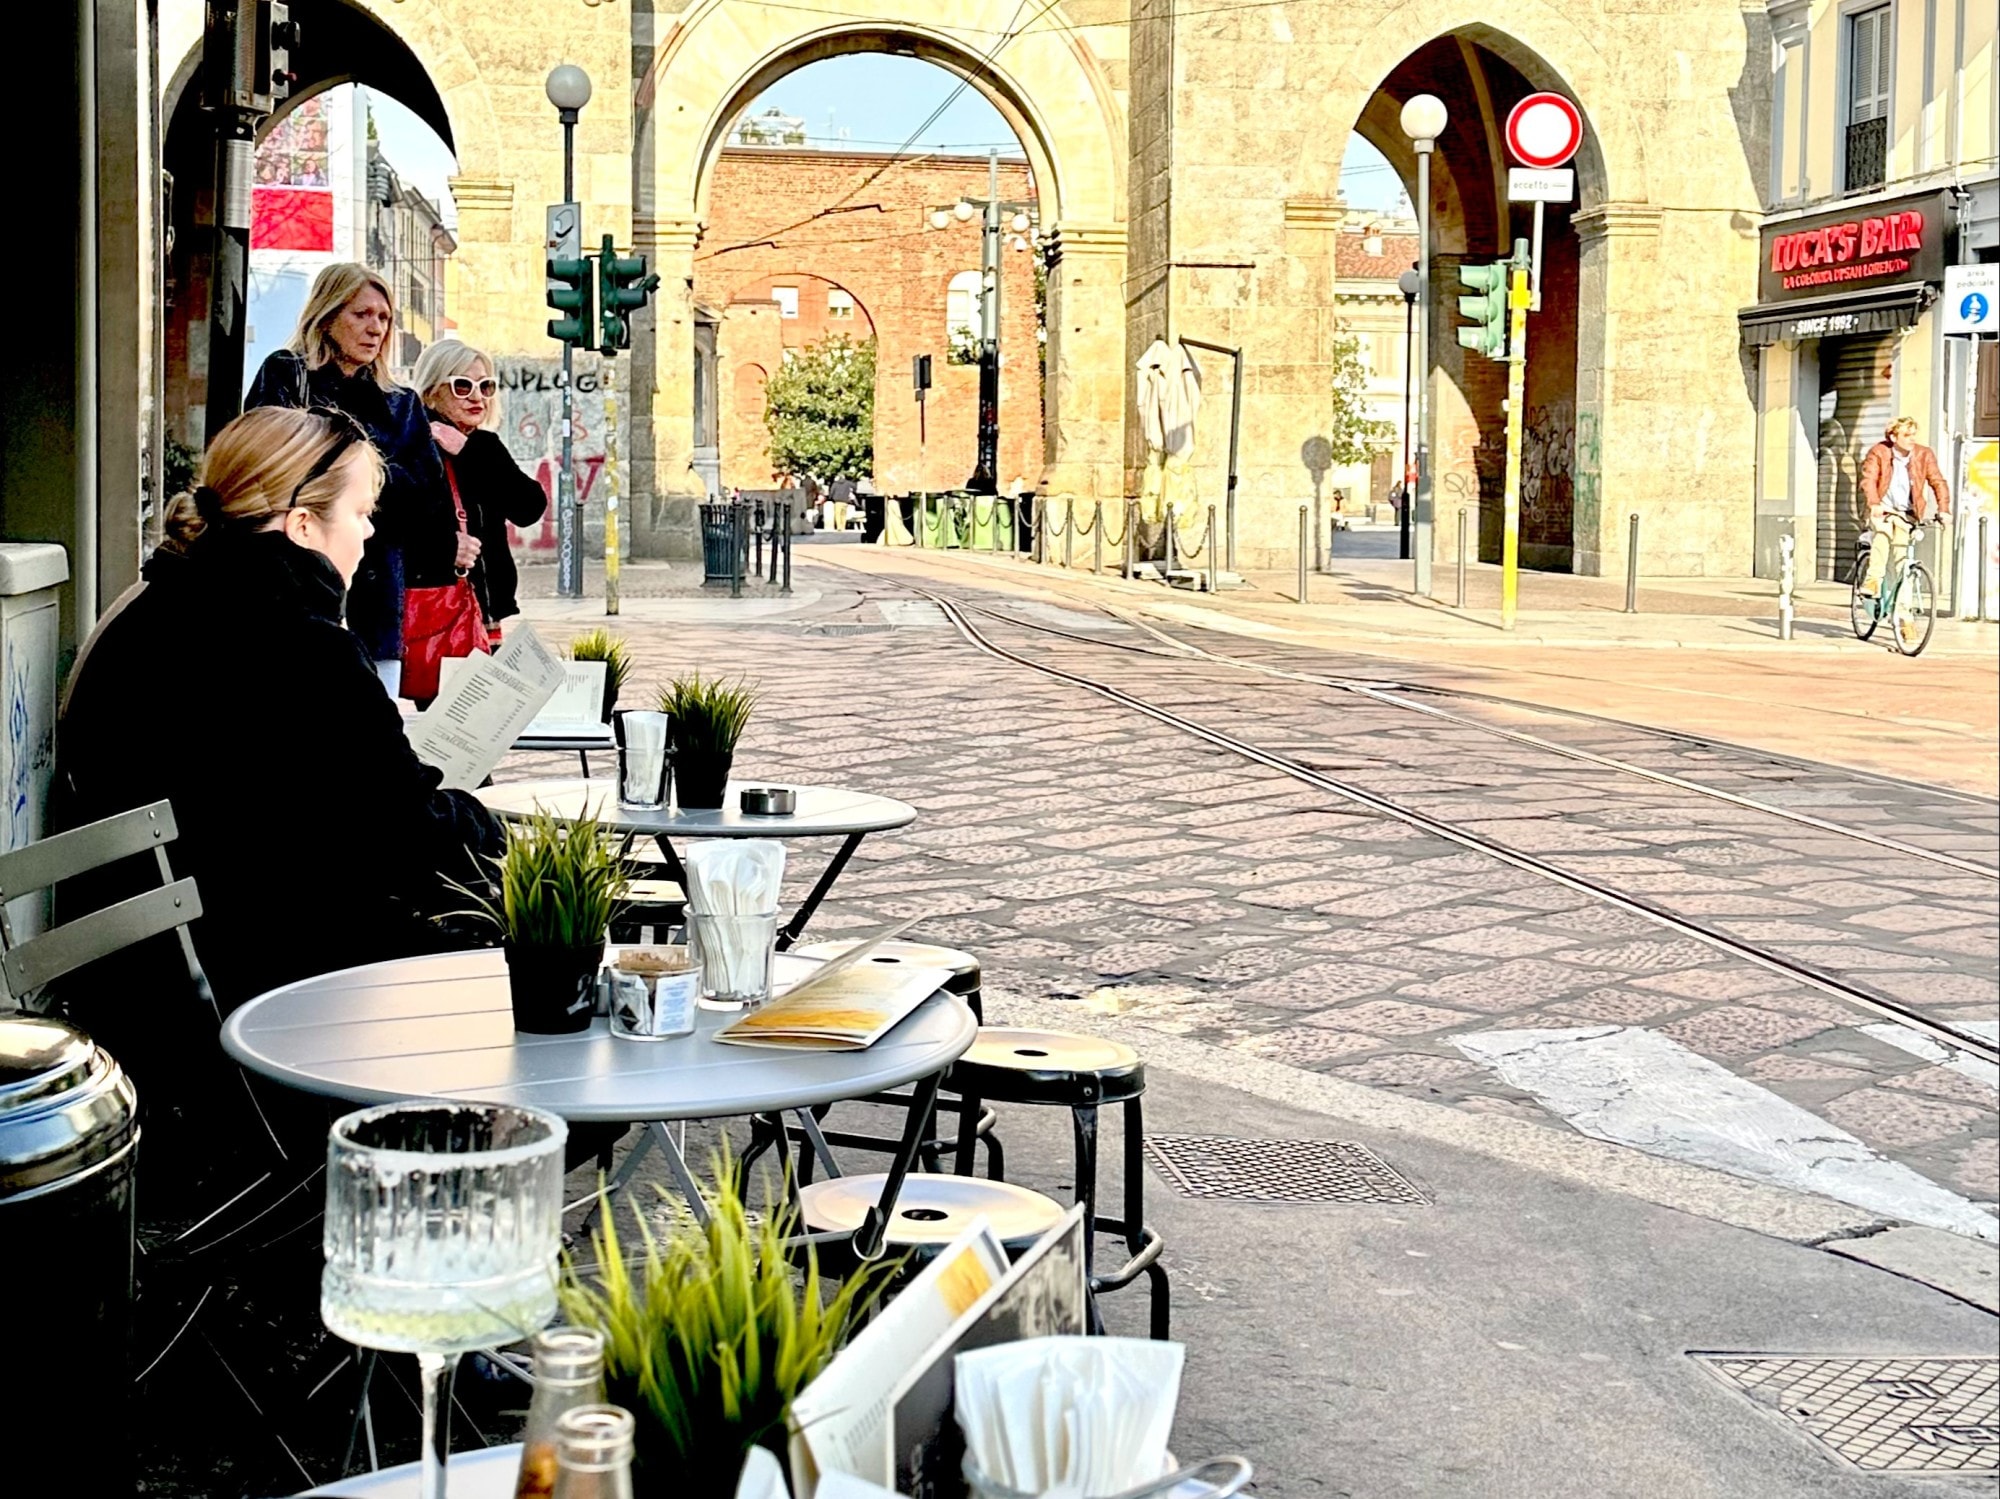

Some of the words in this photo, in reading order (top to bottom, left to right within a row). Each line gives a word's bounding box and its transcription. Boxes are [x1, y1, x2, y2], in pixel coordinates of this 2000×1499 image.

[1771, 223, 1860, 273] LUCA'S
[1860, 210, 1923, 258] BAR
[1797, 316, 1828, 335] SINCE
